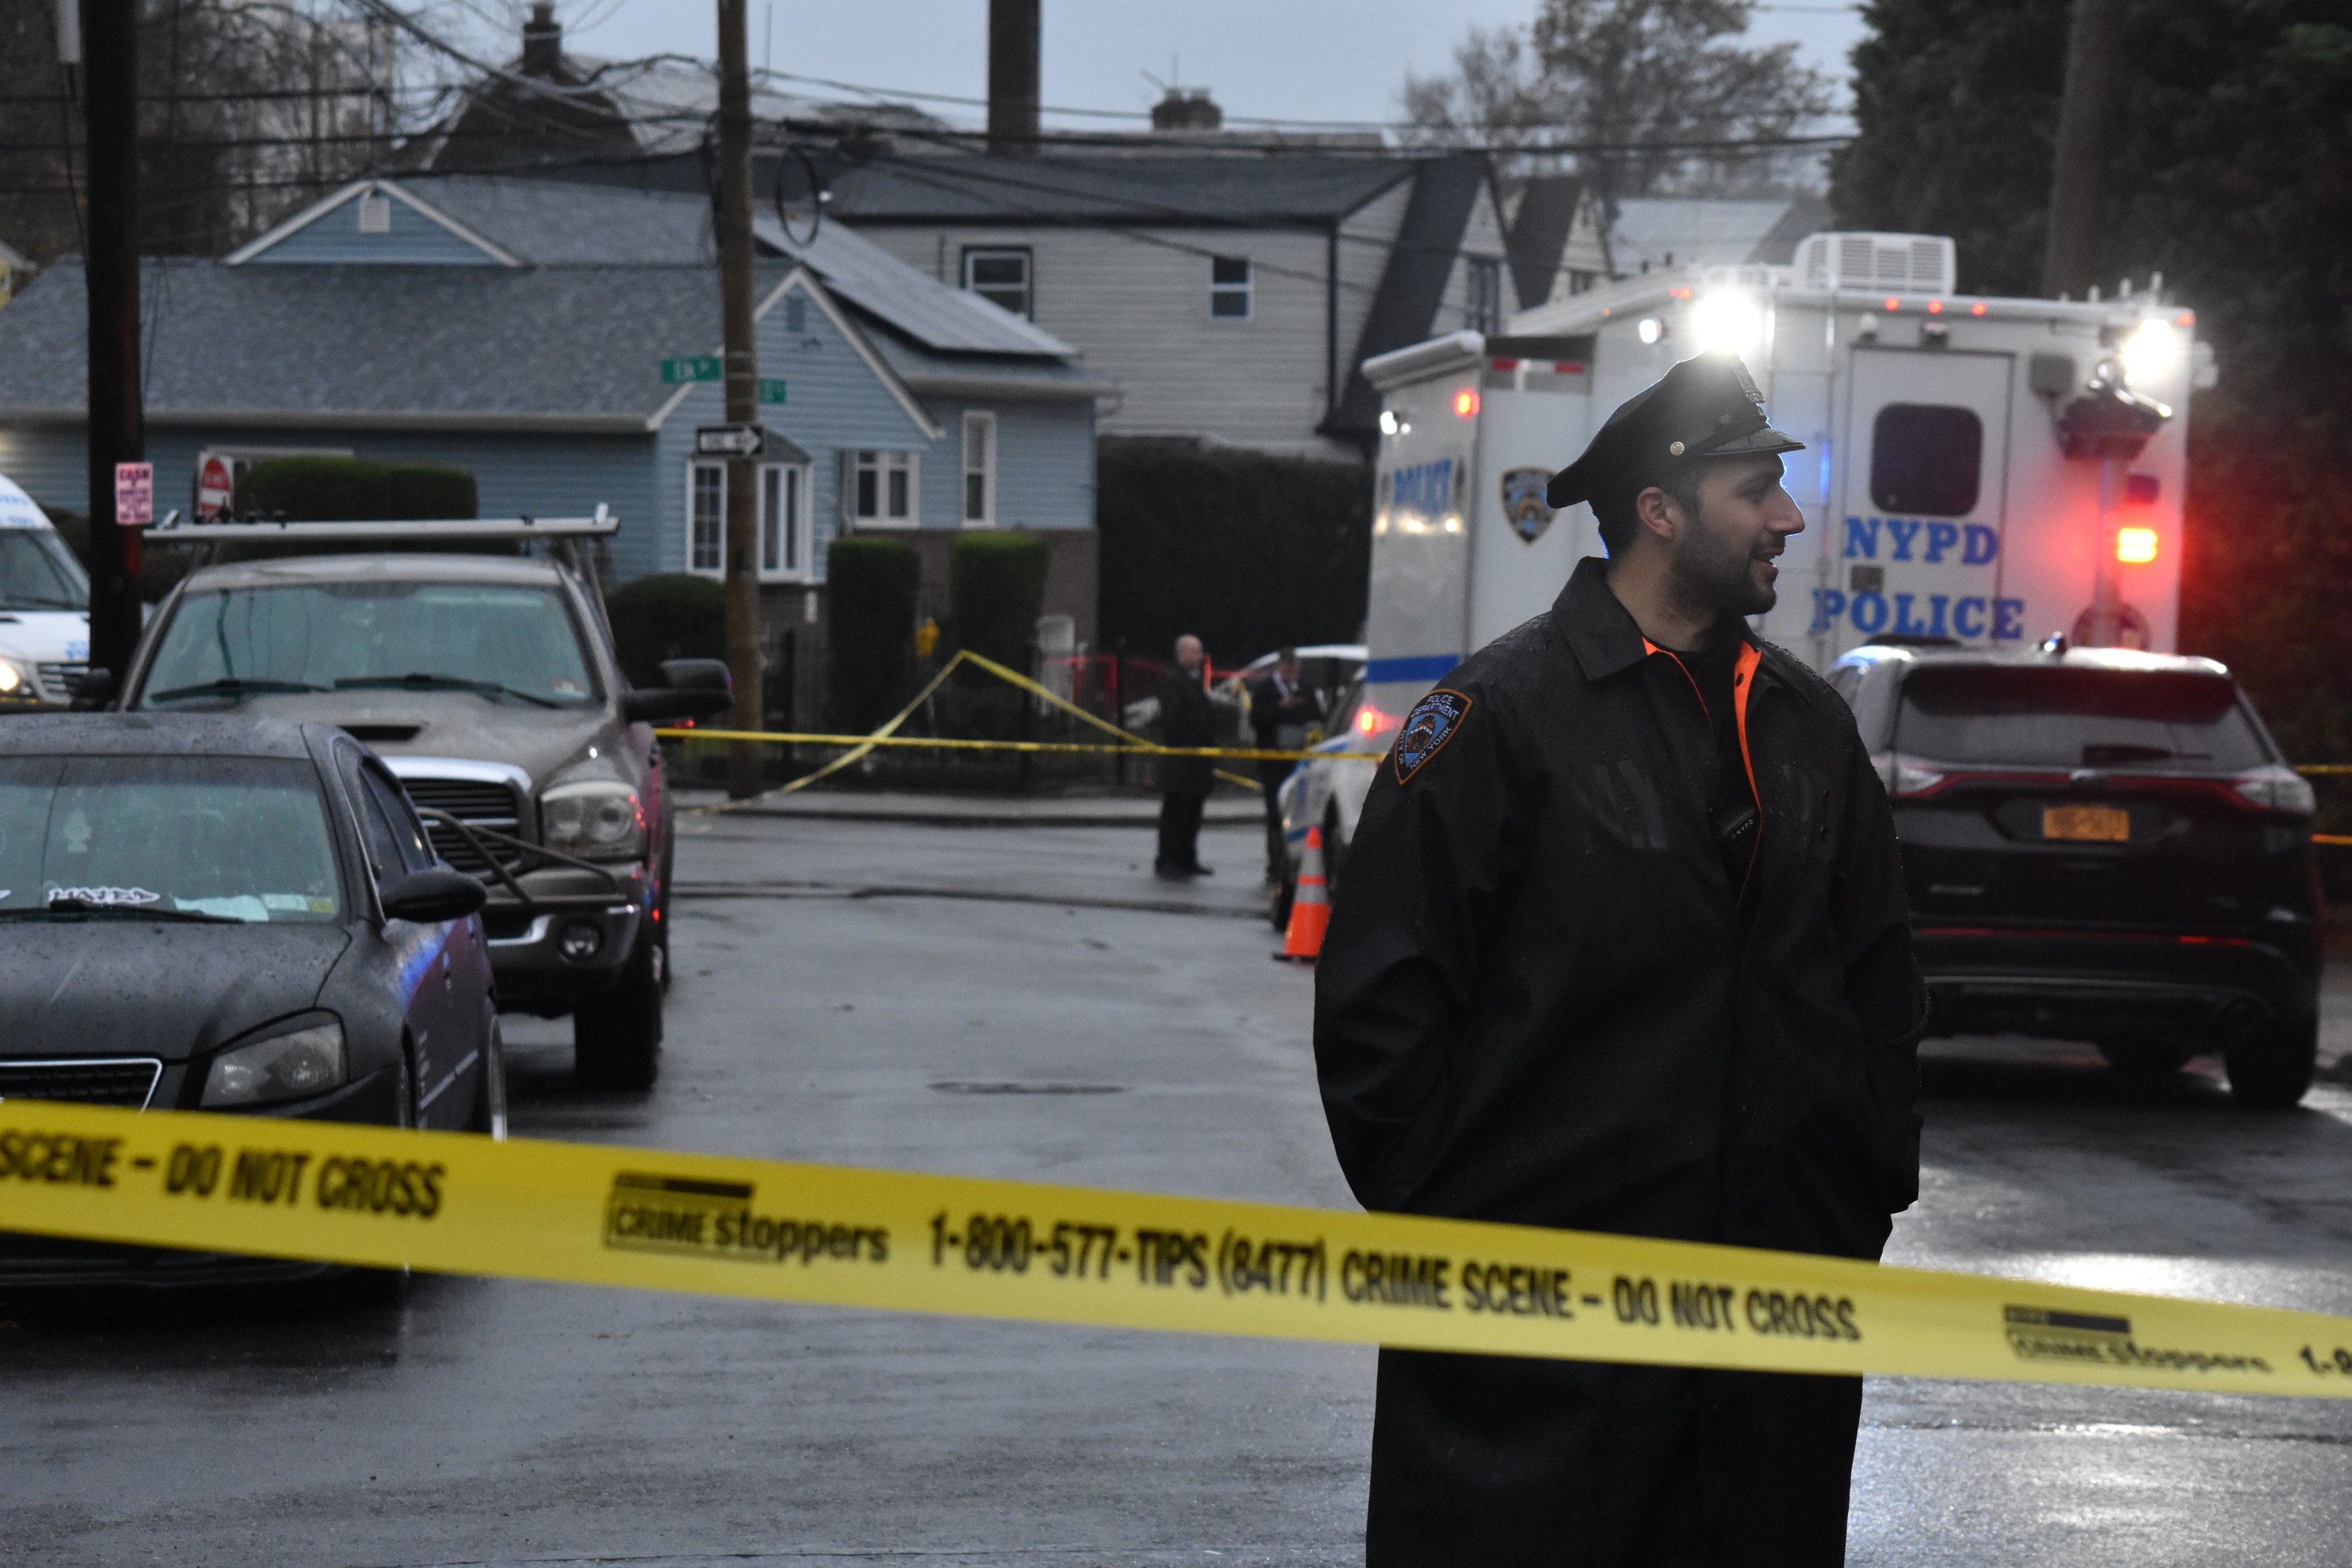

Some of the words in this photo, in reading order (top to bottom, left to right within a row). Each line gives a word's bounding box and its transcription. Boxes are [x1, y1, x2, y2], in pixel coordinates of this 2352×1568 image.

[1842, 516, 2000, 566] NYPD
[1811, 587, 2026, 640] POLICE
[1410, 702, 1459, 720] DEPARTMENT
[1426, 694, 1454, 706] POLICE
[1410, 750, 1427, 770] NEW
[1427, 726, 1453, 750] YORK
[1736, 819, 1754, 836] NYPD
[0, 1128, 123, 1190] SCENE
[166, 1141, 224, 1196] DO
[229, 1147, 315, 1205] NOT
[317, 1154, 447, 1219] CROSS
[1217, 1227, 1327, 1304] (8477)
[1341, 1249, 1452, 1310] CRIME
[1461, 1255, 1574, 1319] SCENE
[1613, 1275, 1661, 1327] DO
[1669, 1279, 1736, 1334] NOT
[1745, 1288, 1862, 1341] CROSS
